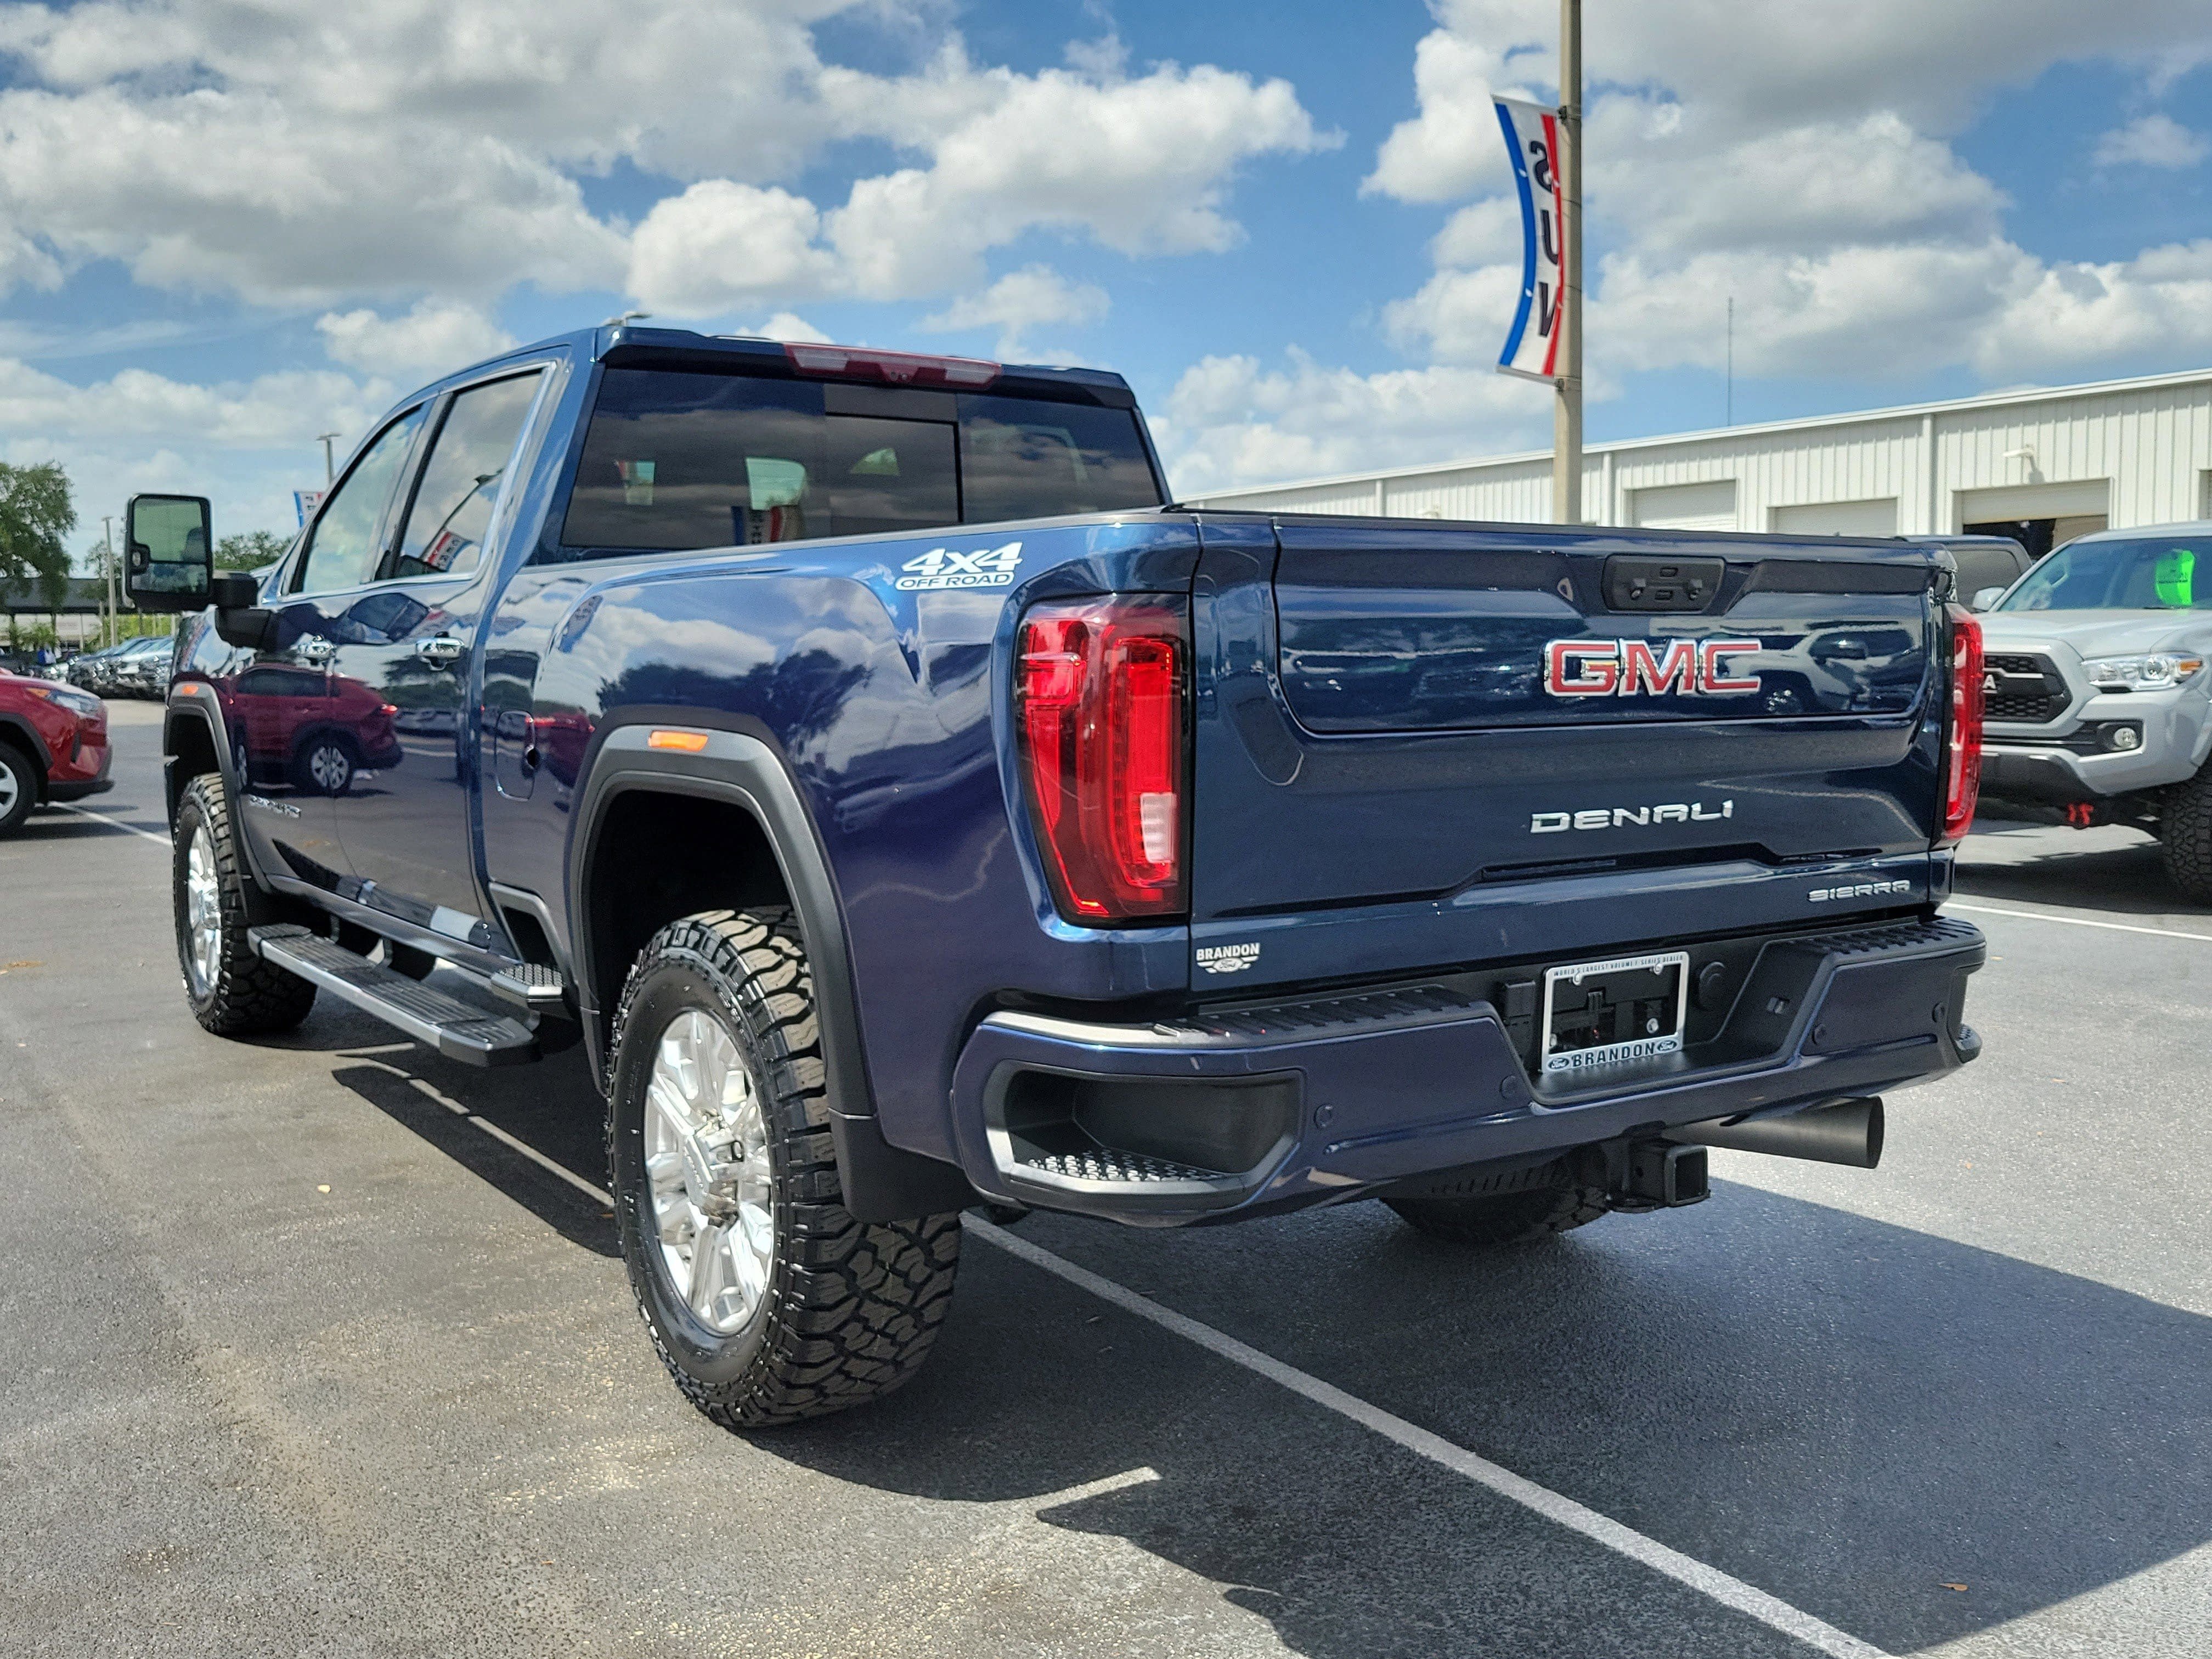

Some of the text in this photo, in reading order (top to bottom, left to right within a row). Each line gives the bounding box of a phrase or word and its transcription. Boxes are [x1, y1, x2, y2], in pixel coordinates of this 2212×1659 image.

[901, 574, 1010, 588] OFF ROAD
[1544, 638, 1762, 697] GMC
[1530, 799, 1734, 833] DENALI
[1807, 879, 1911, 902] SIERRA
[1196, 943, 1260, 961] BRANDON
[1572, 1042, 1655, 1068] BRANDON
